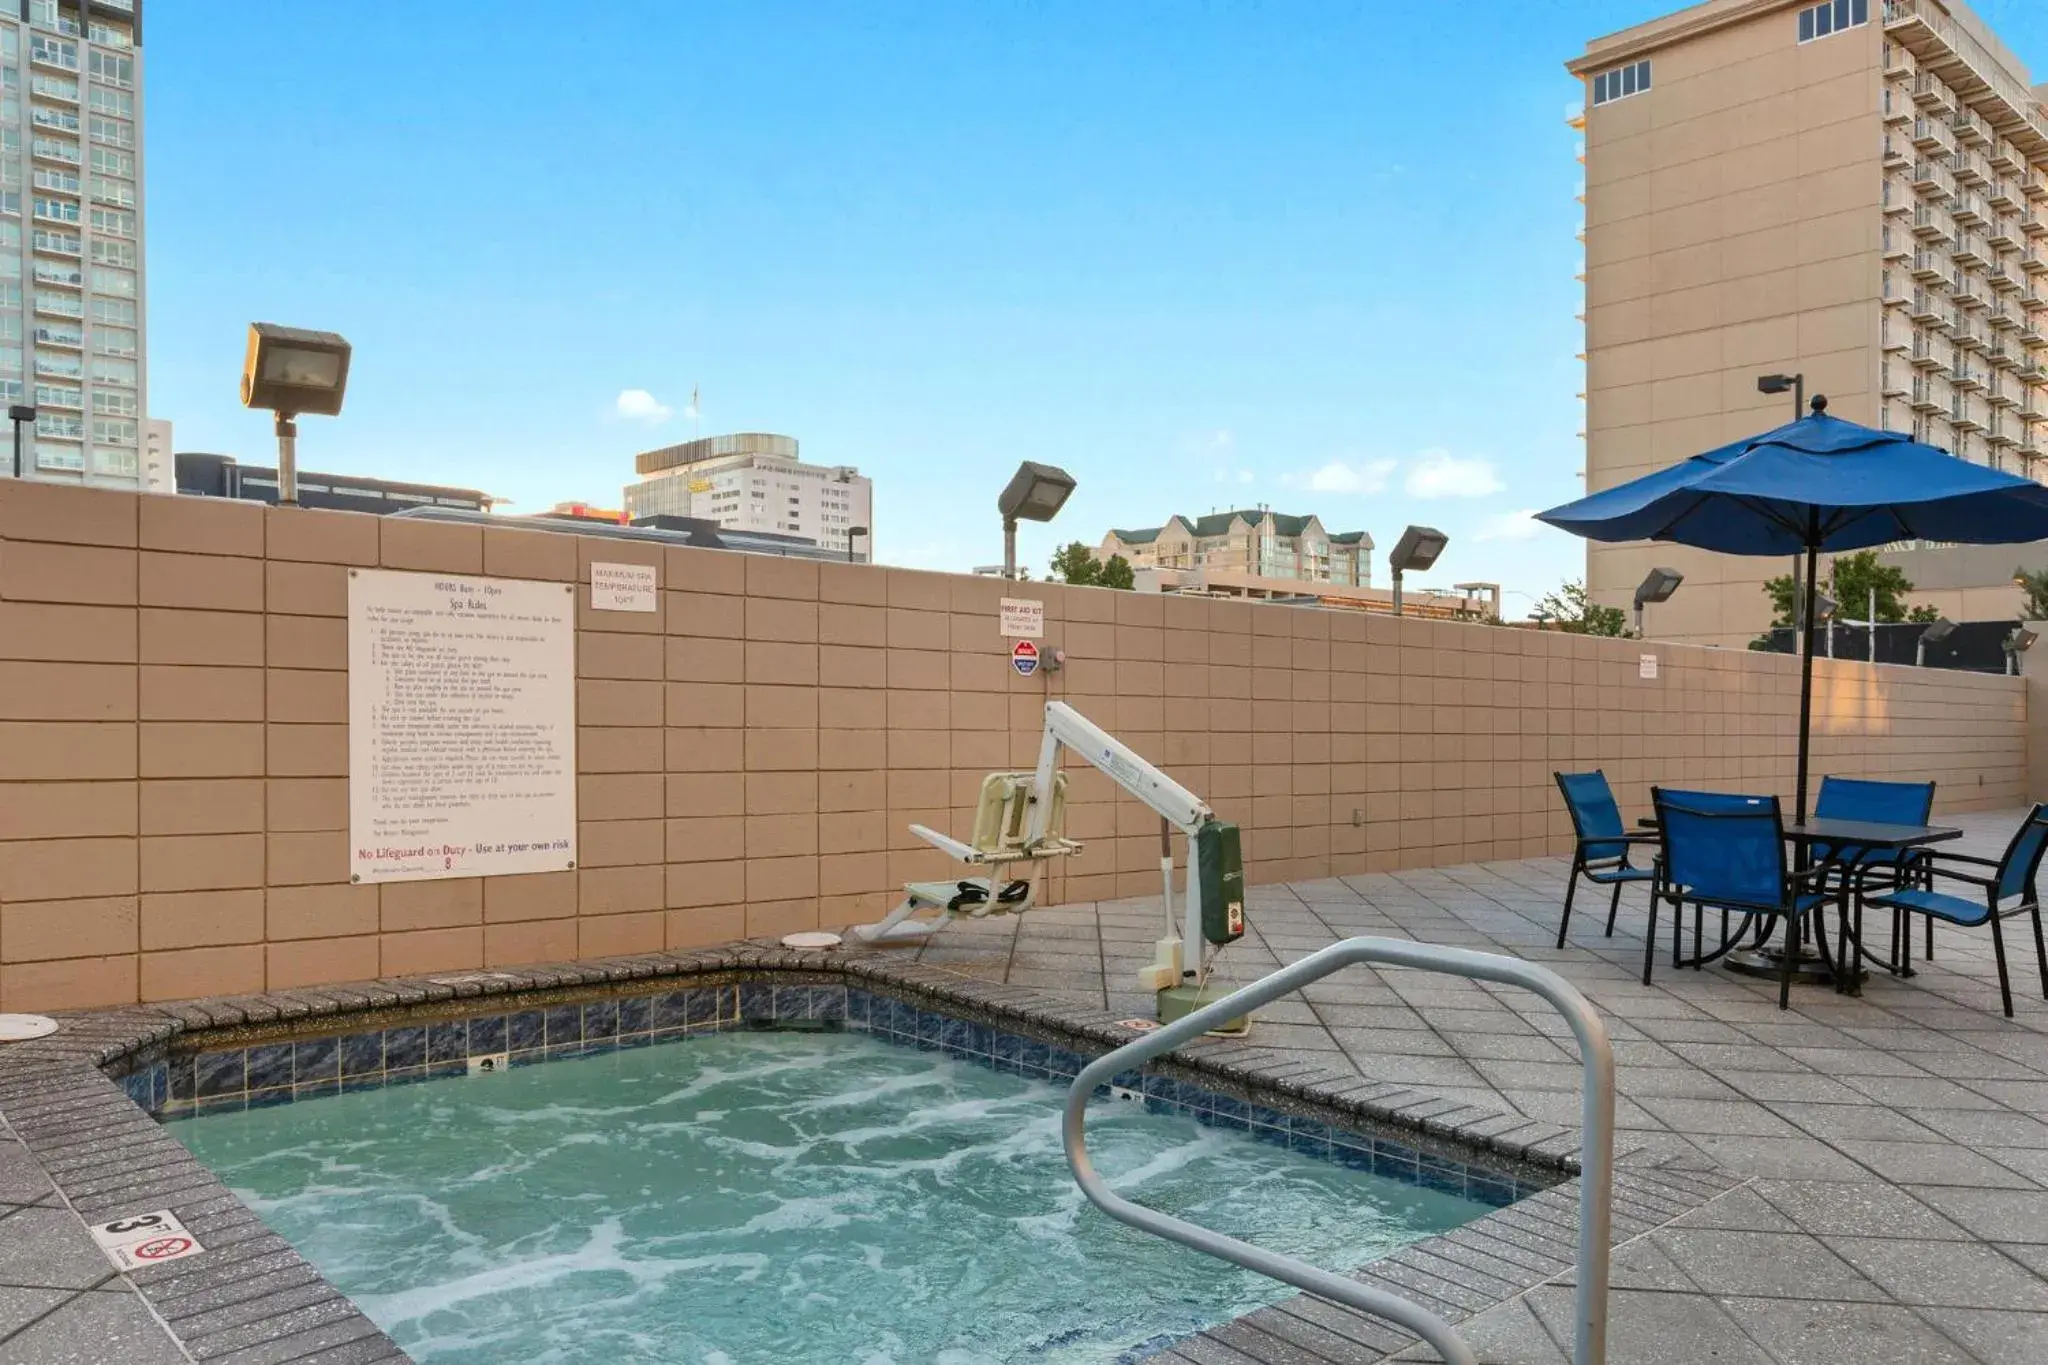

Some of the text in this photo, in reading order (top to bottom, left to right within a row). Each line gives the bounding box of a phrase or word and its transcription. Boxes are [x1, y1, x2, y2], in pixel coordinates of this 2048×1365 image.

[450, 599, 487, 610] Spa Rules
[1001, 604, 1018, 613] FIRST
[358, 848, 373, 859] No
[376, 846, 425, 861] Lifeguard
[427, 848, 441, 856] on
[443, 845, 466, 857] Duty
[475, 843, 493, 853] Use
[495, 843, 506, 852] at
[508, 842, 529, 855] your
[531, 841, 550, 850] own
[552, 839, 569, 849] risk
[105, 1215, 162, 1233] 3
